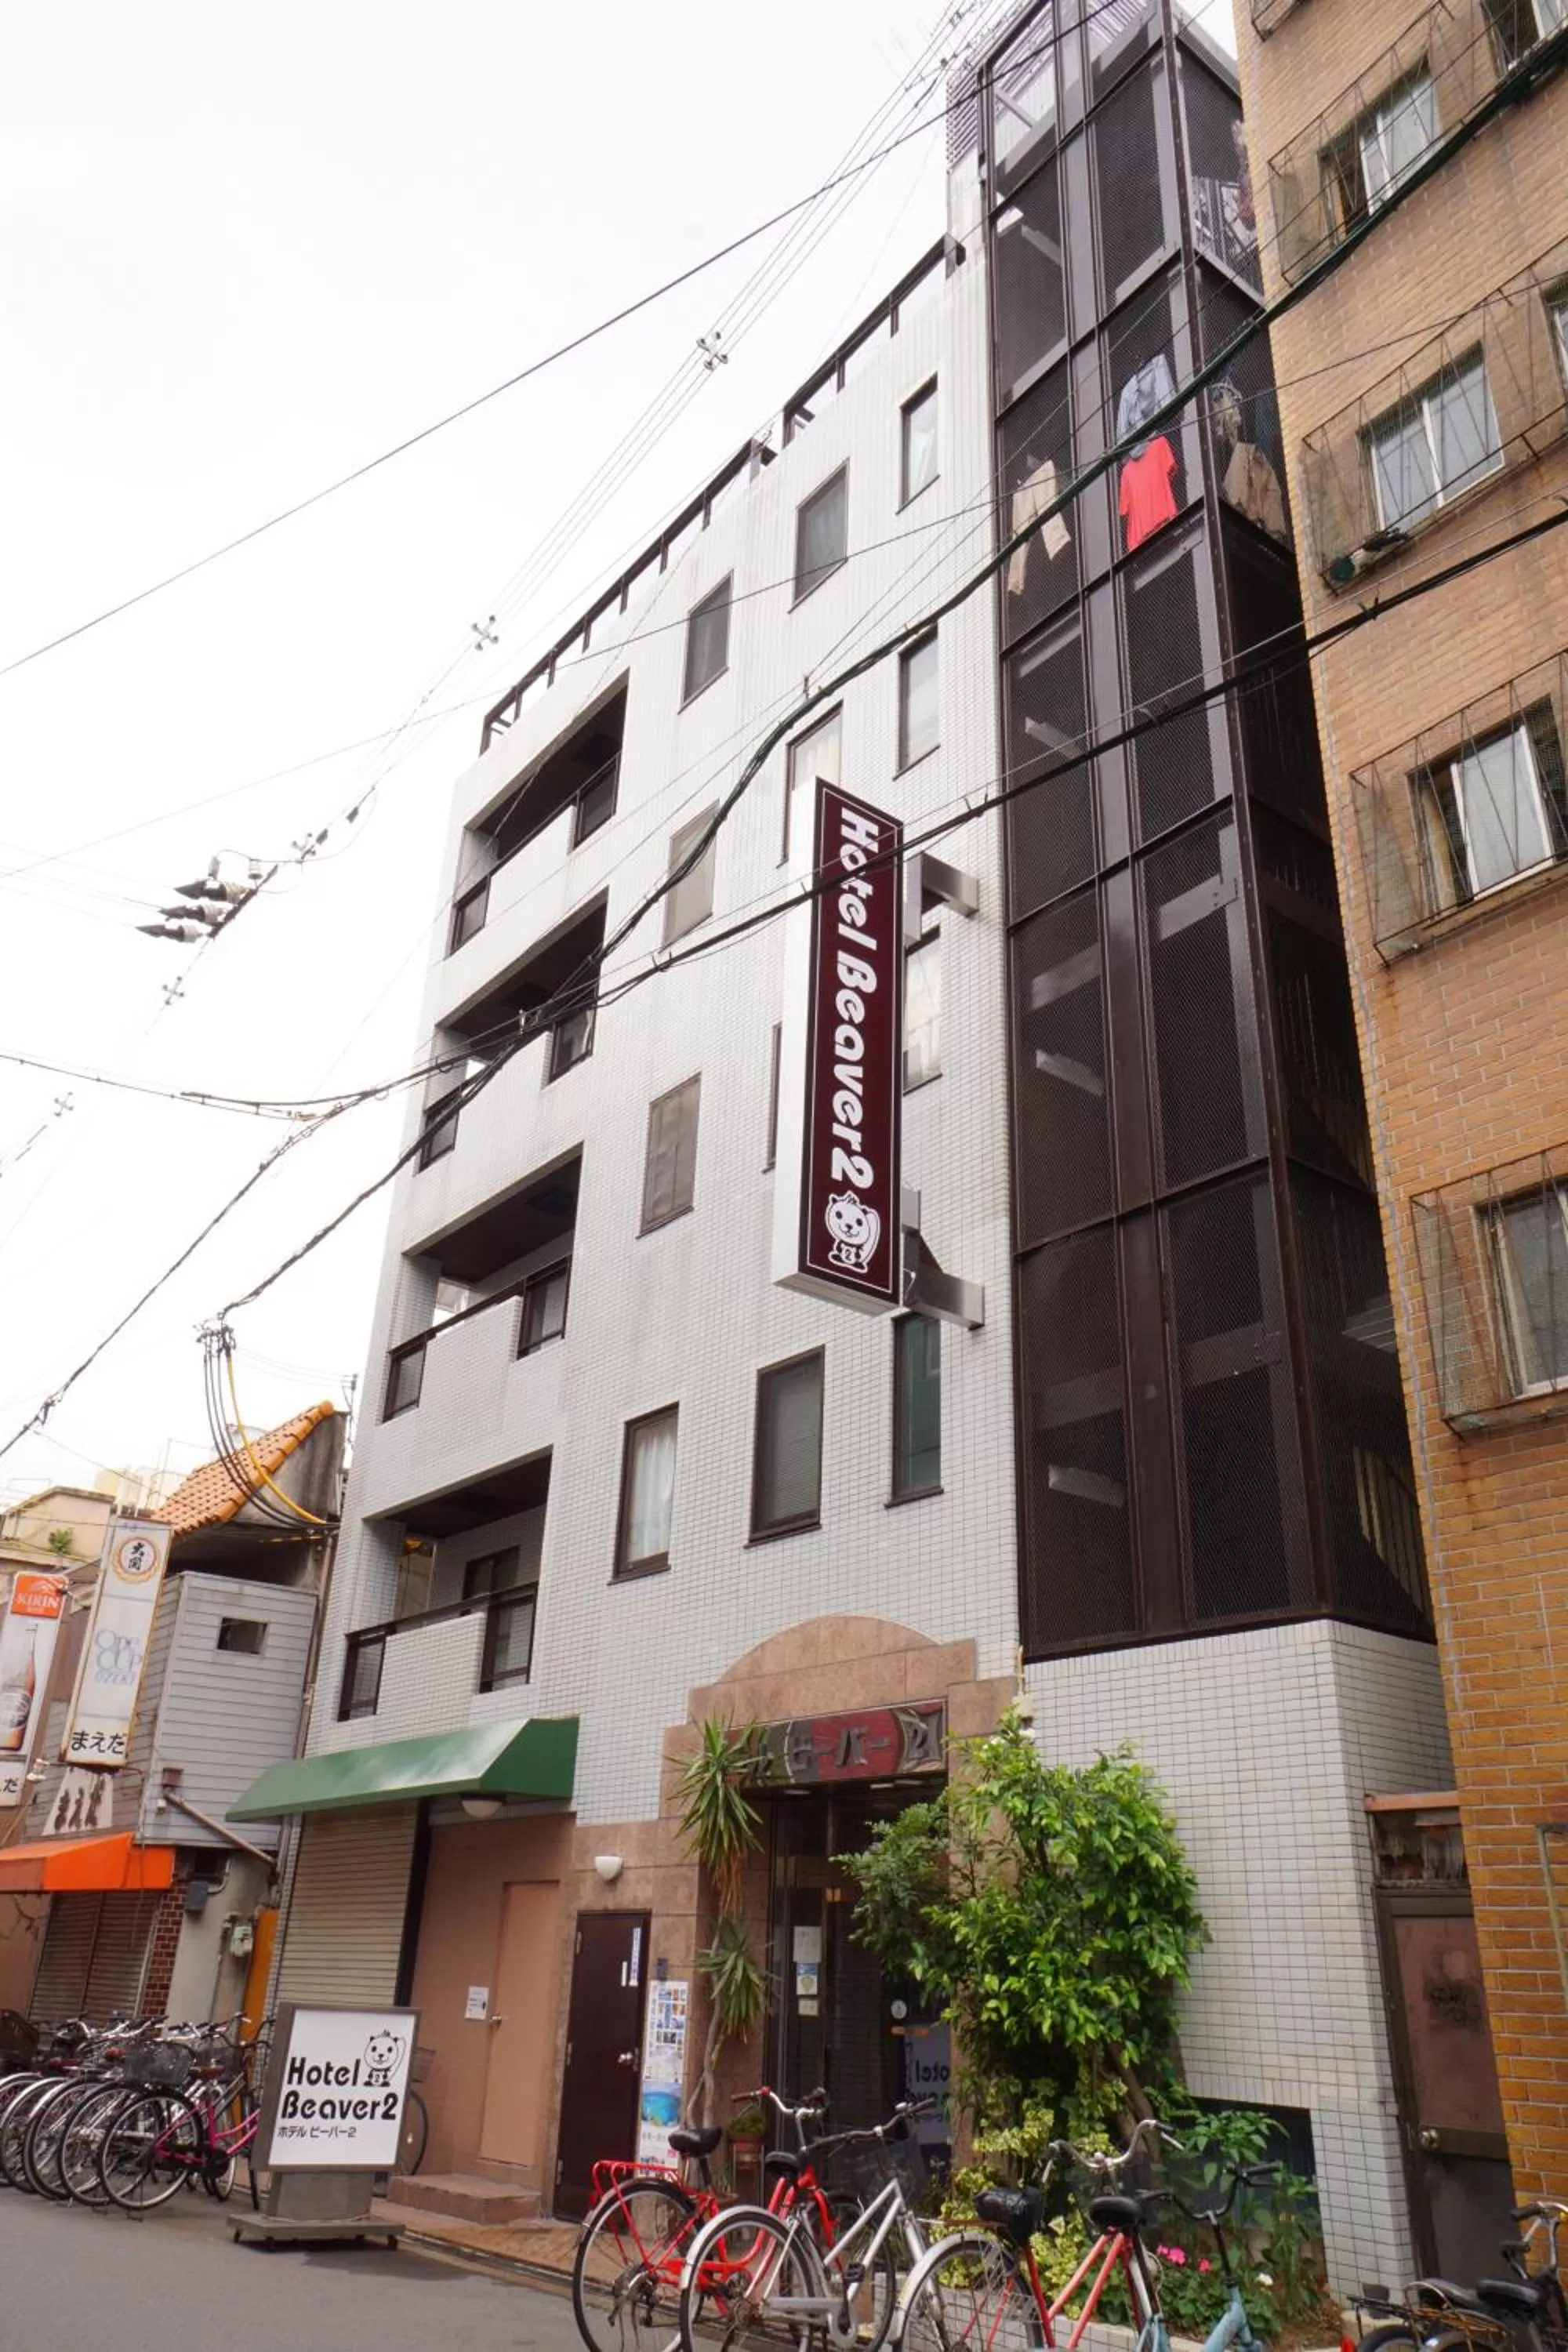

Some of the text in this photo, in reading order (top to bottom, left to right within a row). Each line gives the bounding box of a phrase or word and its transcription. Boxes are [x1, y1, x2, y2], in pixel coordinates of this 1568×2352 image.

[831, 807, 879, 1189] Hotel Beaver2
[16, 1593, 60, 1609] KIRIN
[71, 1730, 125, 1755] まえだ
[287, 2056, 361, 2086] Hotel
[281, 2090, 398, 2120] Beaver2
[278, 2125, 307, 2139] ホテル
